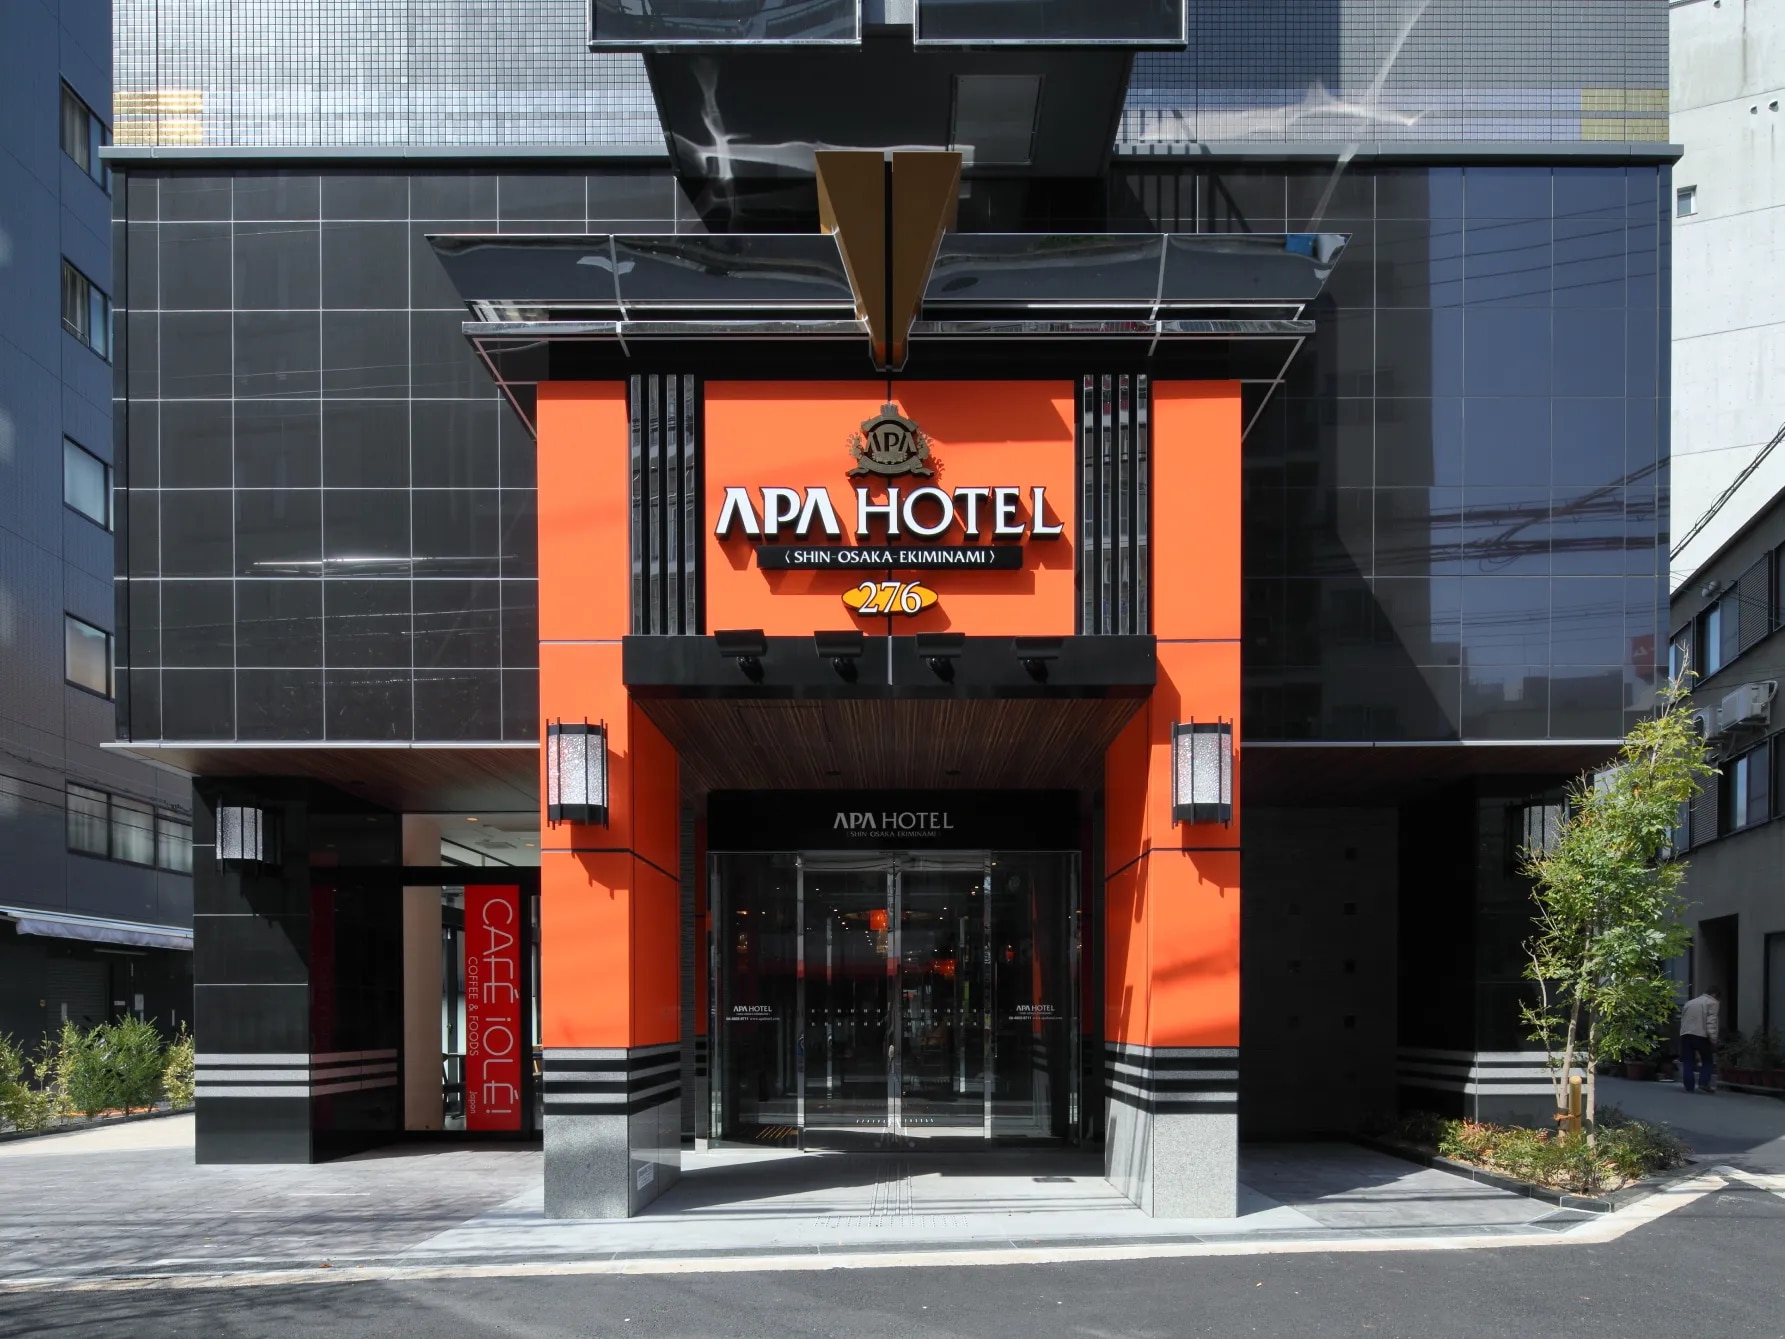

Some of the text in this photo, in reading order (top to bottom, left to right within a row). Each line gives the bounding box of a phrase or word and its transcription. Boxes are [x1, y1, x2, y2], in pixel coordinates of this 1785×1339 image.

[863, 431, 918, 453] APA
[715, 485, 1065, 538] APA HOTEL
[858, 580, 922, 614] 276
[833, 812, 954, 829] APA HOTEL
[482, 898, 519, 1004] CAFÉ
[468, 956, 479, 1056] COFFEE & FOODS
